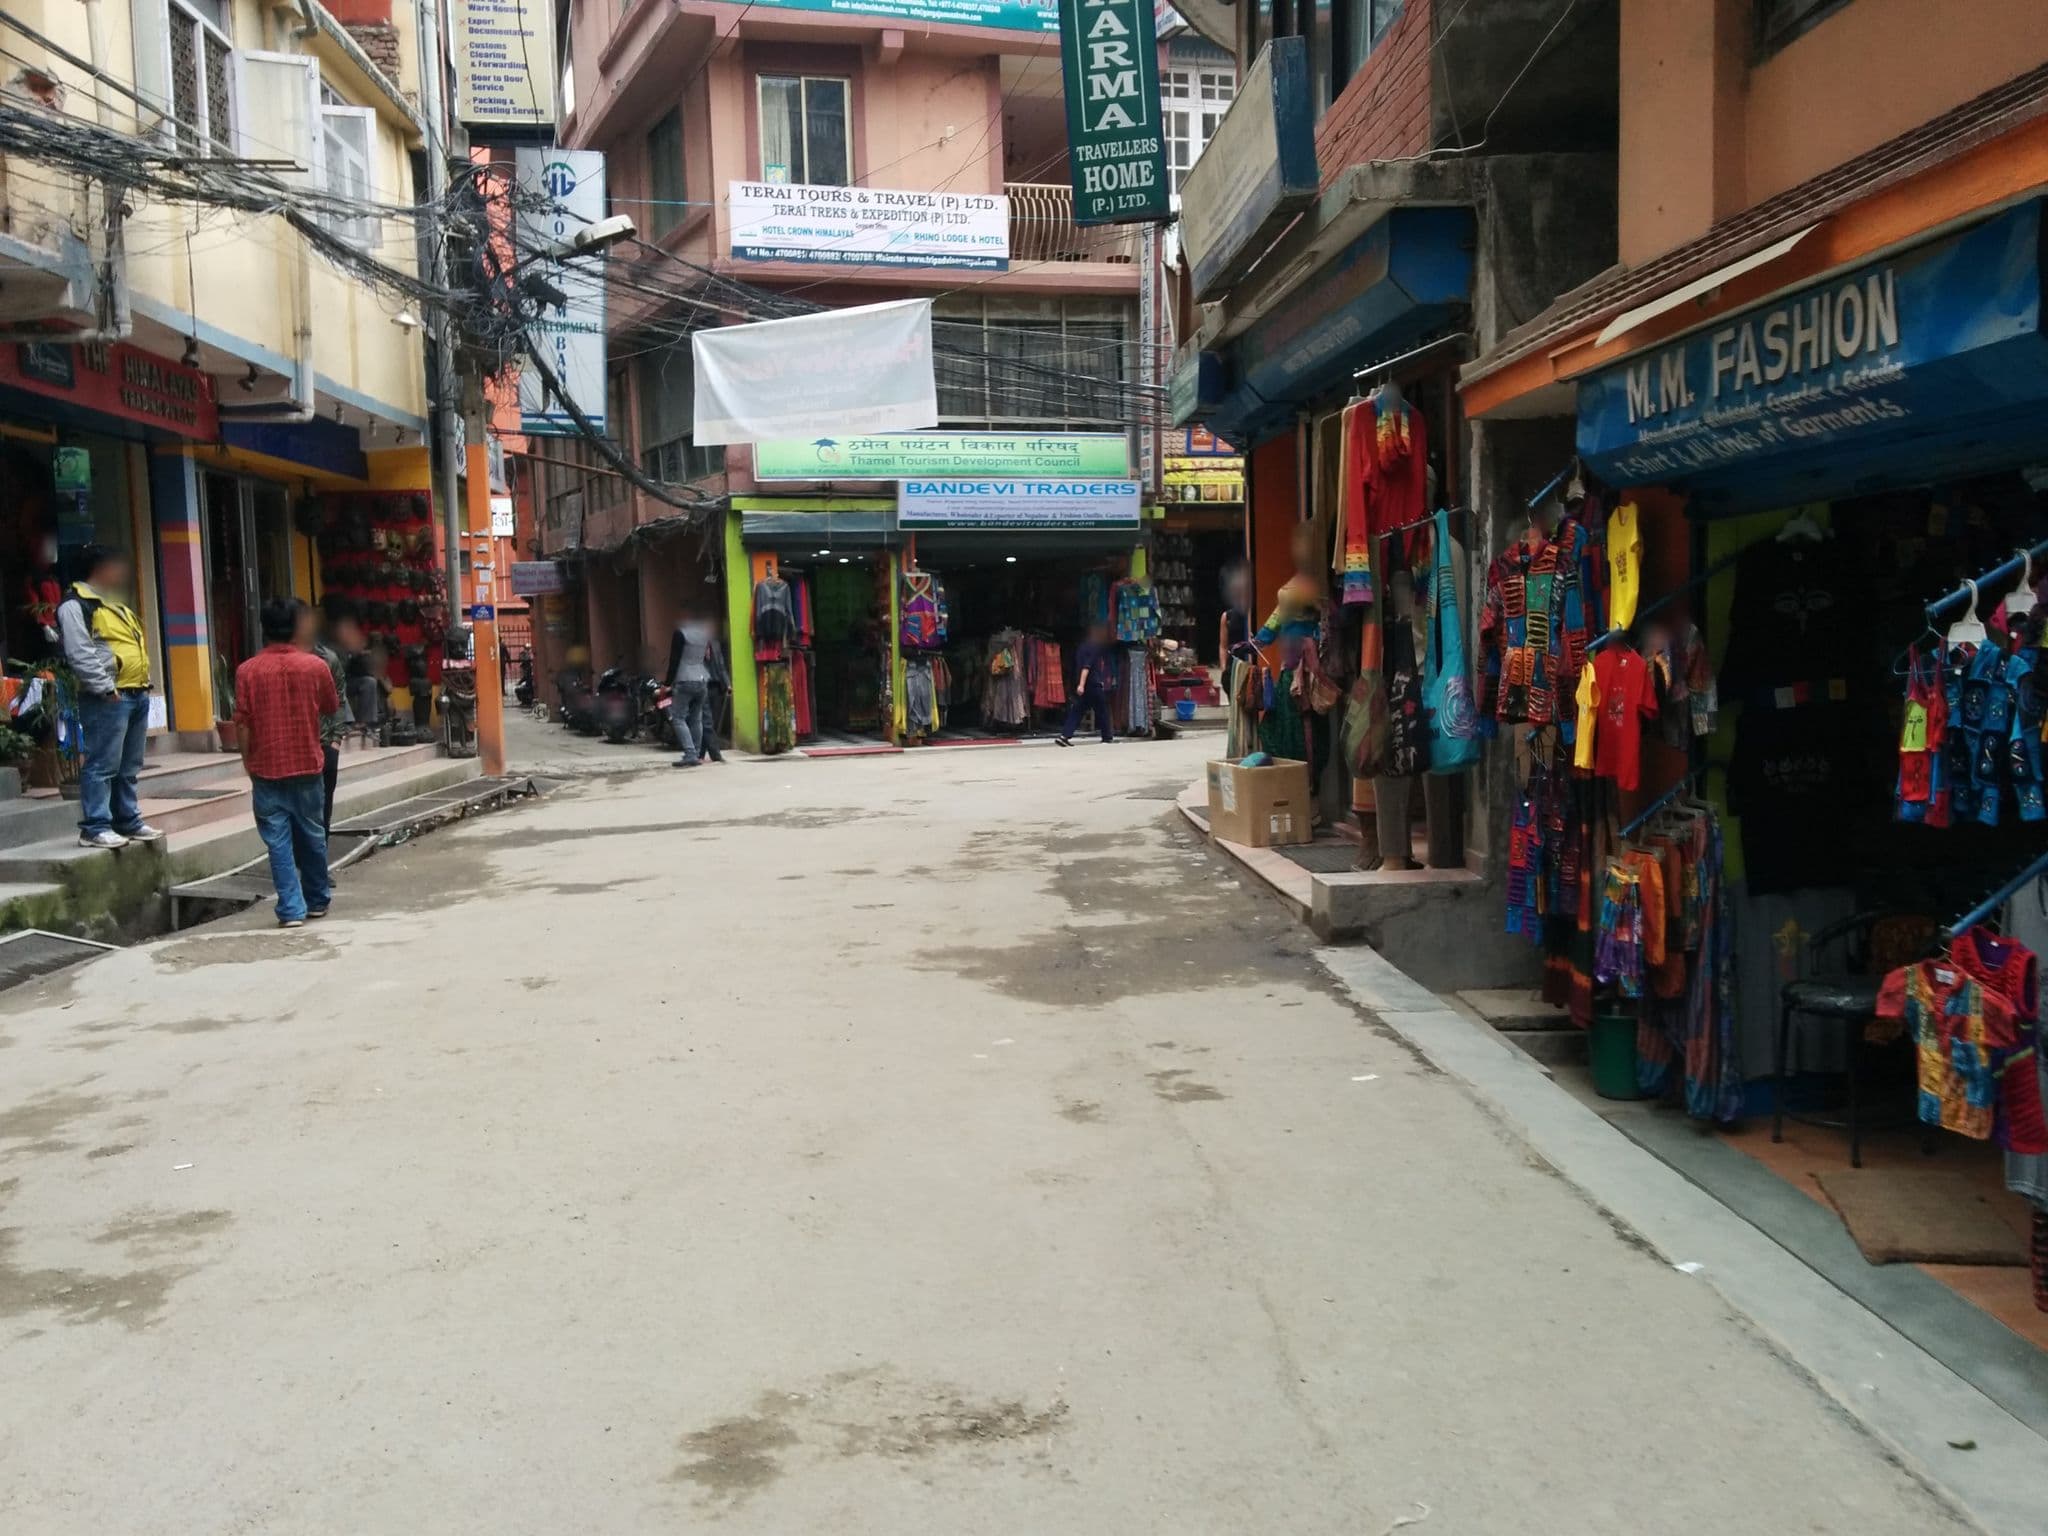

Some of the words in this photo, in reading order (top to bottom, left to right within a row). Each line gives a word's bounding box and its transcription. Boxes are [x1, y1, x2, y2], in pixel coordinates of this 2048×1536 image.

[468, 17, 495, 26] Export
[468, 27, 534, 37] Documentation
[469, 42, 507, 50] Customs
[470, 51, 506, 59] Clearing
[478, 60, 527, 70] Forwarding
[1085, 0, 1139, 131] ARMA
[471, 74, 491, 82] Door
[493, 74, 501, 82] to
[503, 75, 524, 83] Door
[472, 96, 507, 105] Packing
[512, 106, 544, 115] Service
[1076, 137, 1158, 162] TRAVELLERS
[1083, 160, 1155, 193] HOME
[741, 185, 792, 199] TERAI
[798, 188, 852, 203] TOURS
[857, 192, 870, 203] &
[874, 193, 936, 207] TRAVEL
[941, 196, 960, 210] (P)
[965, 198, 998, 210] LTD.
[1092, 198, 1115, 215] (P.)
[1117, 193, 1151, 209] LTD.
[772, 204, 806, 217] TERAI
[810, 206, 847, 219] TREKS
[850, 209, 859, 219] &
[862, 208, 927, 222] EXPEDITION
[930, 211, 943, 225] (P)
[947, 212, 970, 225] LTD.
[762, 226, 785, 235] HOTEL
[787, 227, 813, 236] CROWN
[914, 232, 940, 242] RHINO
[942, 233, 968, 243] LODGE
[971, 235, 976, 243] &
[979, 235, 1005, 245] HOTEL
[745, 247, 758, 256] Tel
[1711, 269, 1898, 398] FASHION
[1613, 451, 1678, 478] T-Shirt
[1759, 420, 1786, 444] of
[1780, 397, 1912, 438] Garments.
[848, 438, 889, 451] ठमेल
[961, 438, 1016, 451] विकास
[850, 456, 895, 466] Thamel
[899, 456, 949, 466] Tourism
[953, 457, 1031, 467] Development
[1035, 457, 1080, 467] Council
[906, 482, 1014, 494] BANDEVI
[1022, 483, 1136, 495] TRADERS
